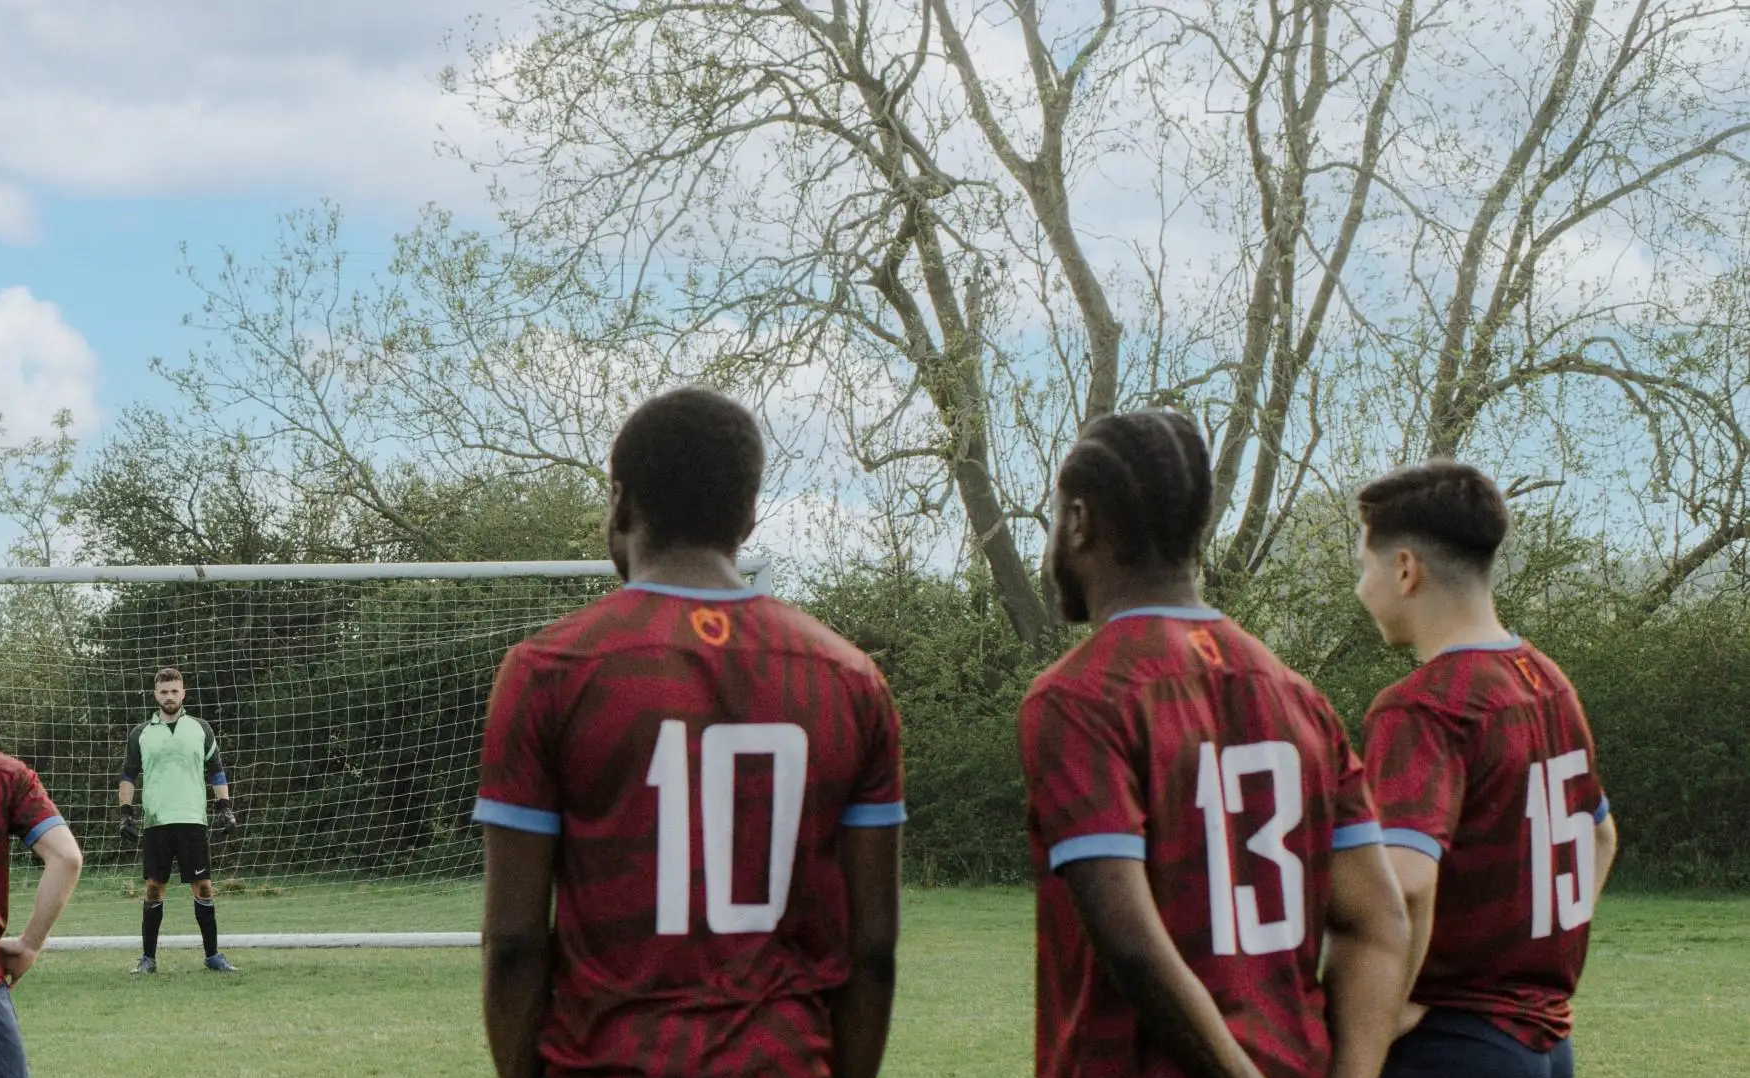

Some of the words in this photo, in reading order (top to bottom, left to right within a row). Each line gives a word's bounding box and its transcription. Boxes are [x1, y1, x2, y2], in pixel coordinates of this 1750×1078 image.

[645, 719, 809, 936] 10
[1195, 741, 1306, 956] 13
[1525, 749, 1595, 939] 15
